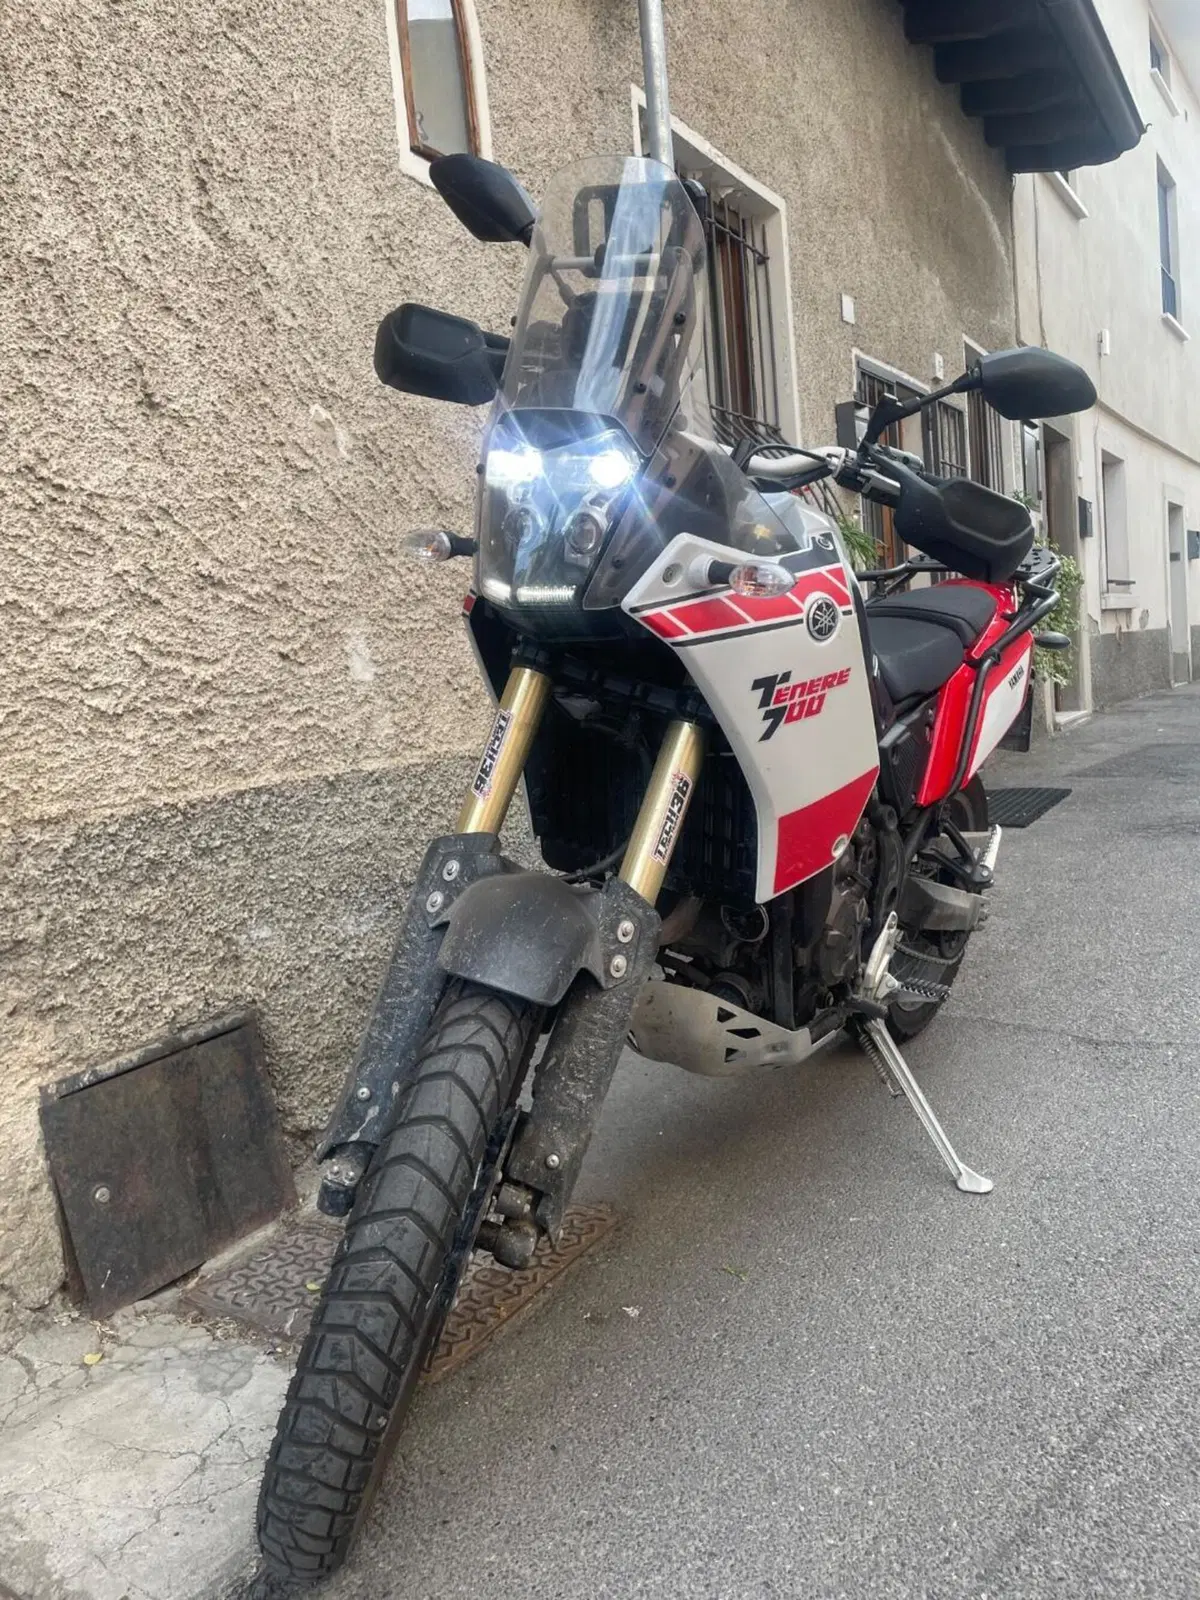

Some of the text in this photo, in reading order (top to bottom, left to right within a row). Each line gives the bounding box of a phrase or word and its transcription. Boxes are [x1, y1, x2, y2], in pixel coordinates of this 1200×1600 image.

[473, 713, 511, 794] TECH36
[758, 693, 827, 742] 700
[653, 776, 691, 857] TECH36
